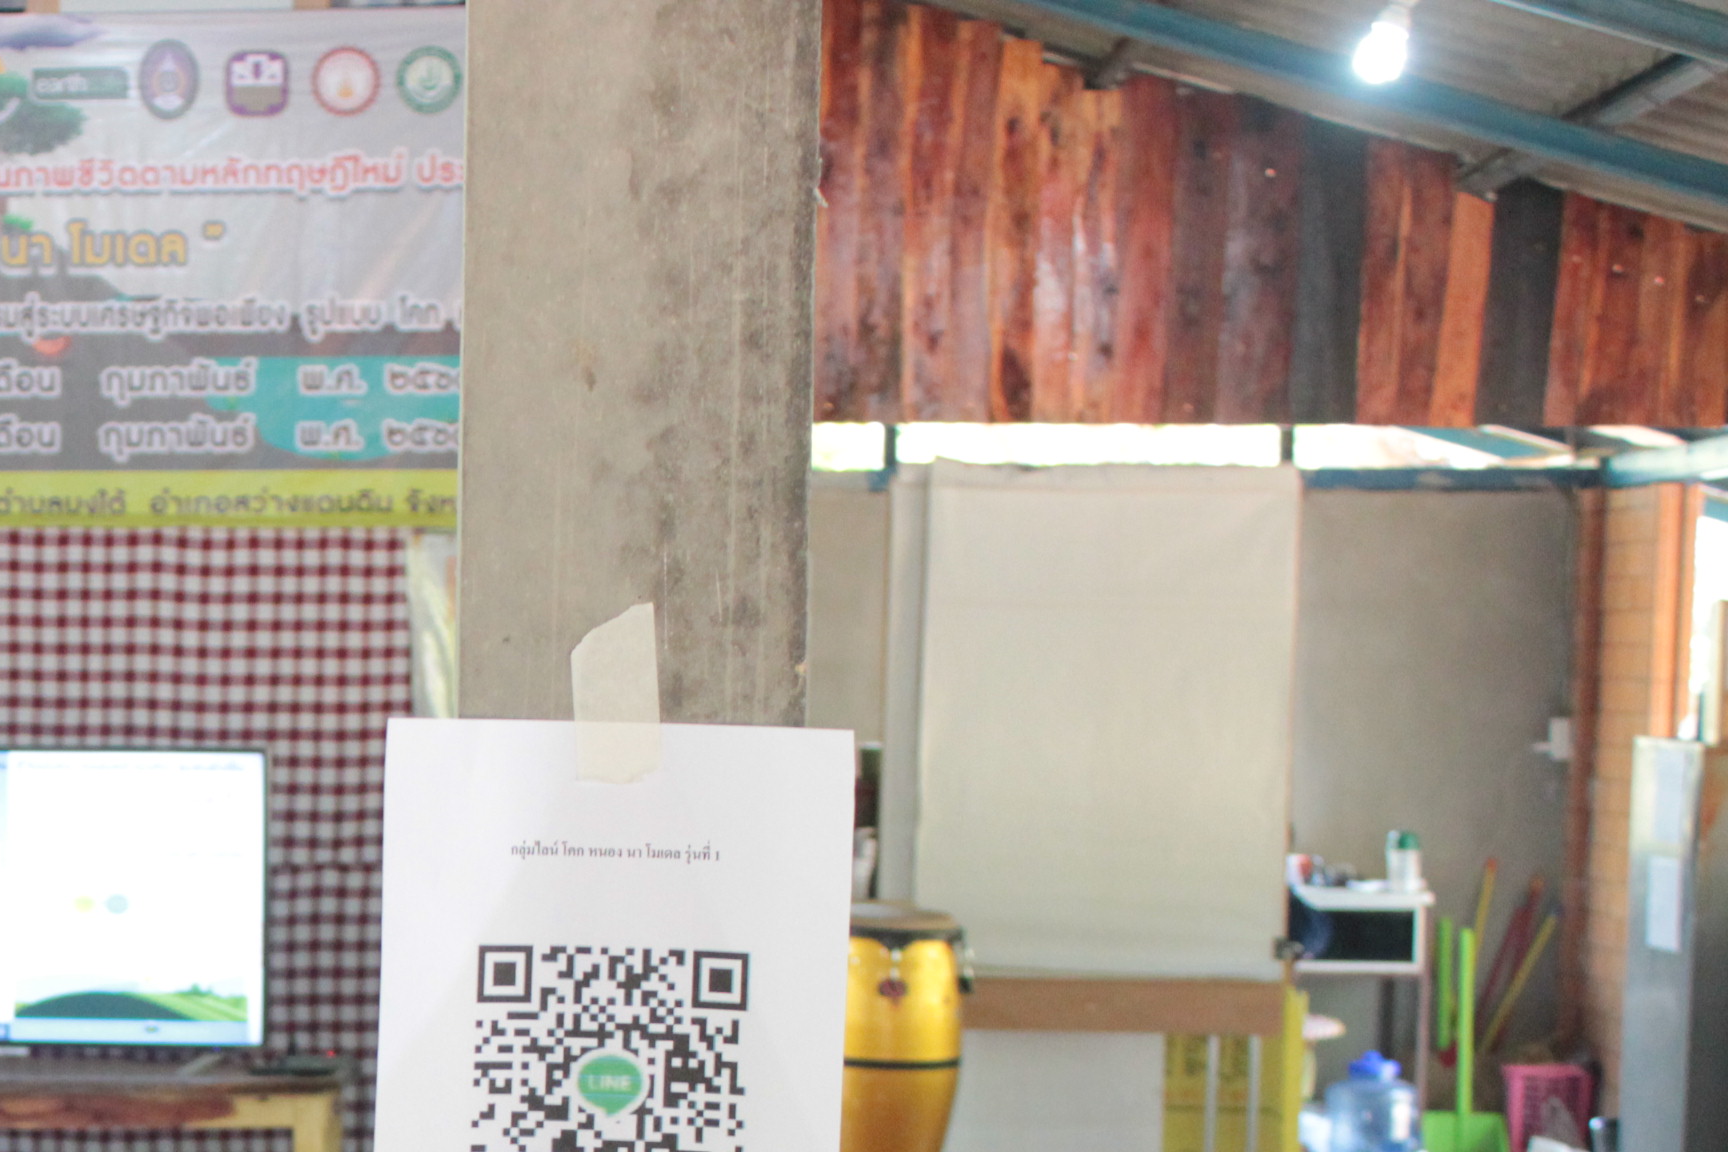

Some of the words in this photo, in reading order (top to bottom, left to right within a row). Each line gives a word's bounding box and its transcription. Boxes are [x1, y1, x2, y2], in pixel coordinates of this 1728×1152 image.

[1, 232, 54, 267] นา
[69, 221, 187, 266] โมเดล
[303, 297, 383, 341] รูปแบบ
[101, 357, 257, 407] กุมภาพันธ์
[299, 364, 366, 396] พ.ศ.
[99, 413, 256, 462] กุมภาพันธ์
[296, 419, 363, 451] พ.ศ.
[384, 418, 459, 450] ๒๕๖
[510, 839, 560, 860] กลุ่มไลน์
[562, 841, 585, 858] โคก
[588, 846, 623, 859] หนอง
[627, 847, 643, 859] นา
[645, 843, 682, 860] โมเดล
[684, 840, 712, 864] รุ่นที่
[587, 1074, 631, 1091] LINE
